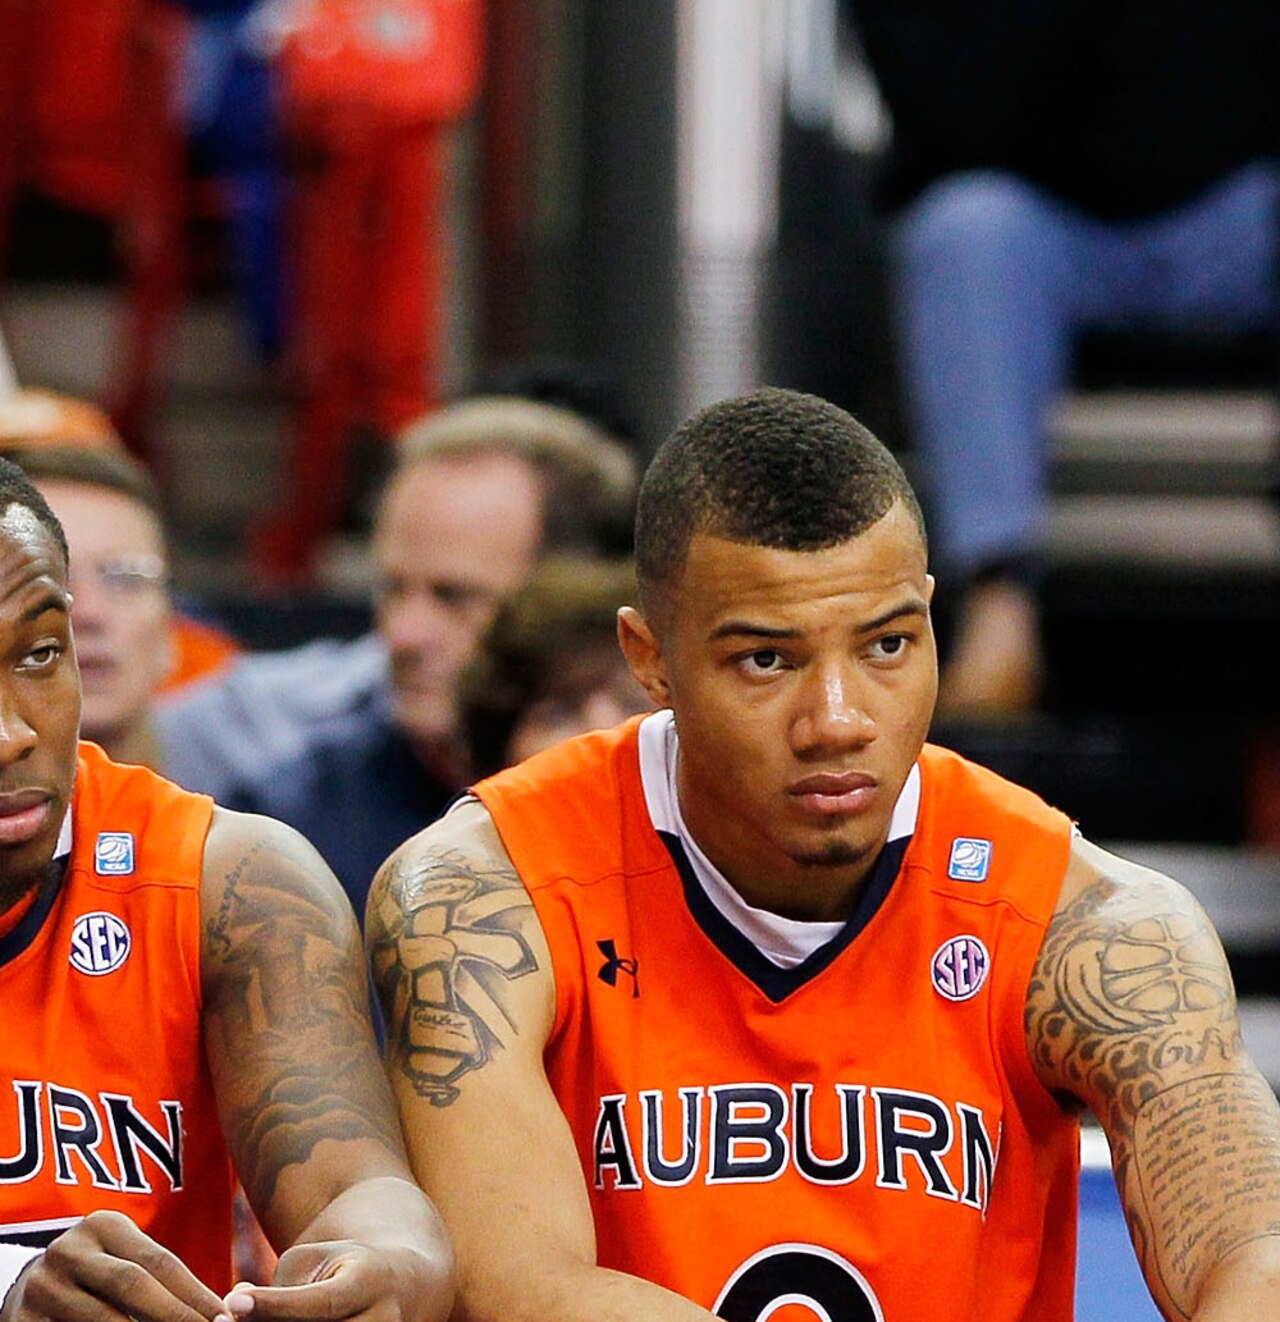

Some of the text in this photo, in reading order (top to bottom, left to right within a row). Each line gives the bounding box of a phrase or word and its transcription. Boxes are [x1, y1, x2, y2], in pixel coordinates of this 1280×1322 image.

[70, 914, 128, 972] SEC
[934, 938, 985, 998] SEC
[594, 1083, 1002, 1222] AUBURN
